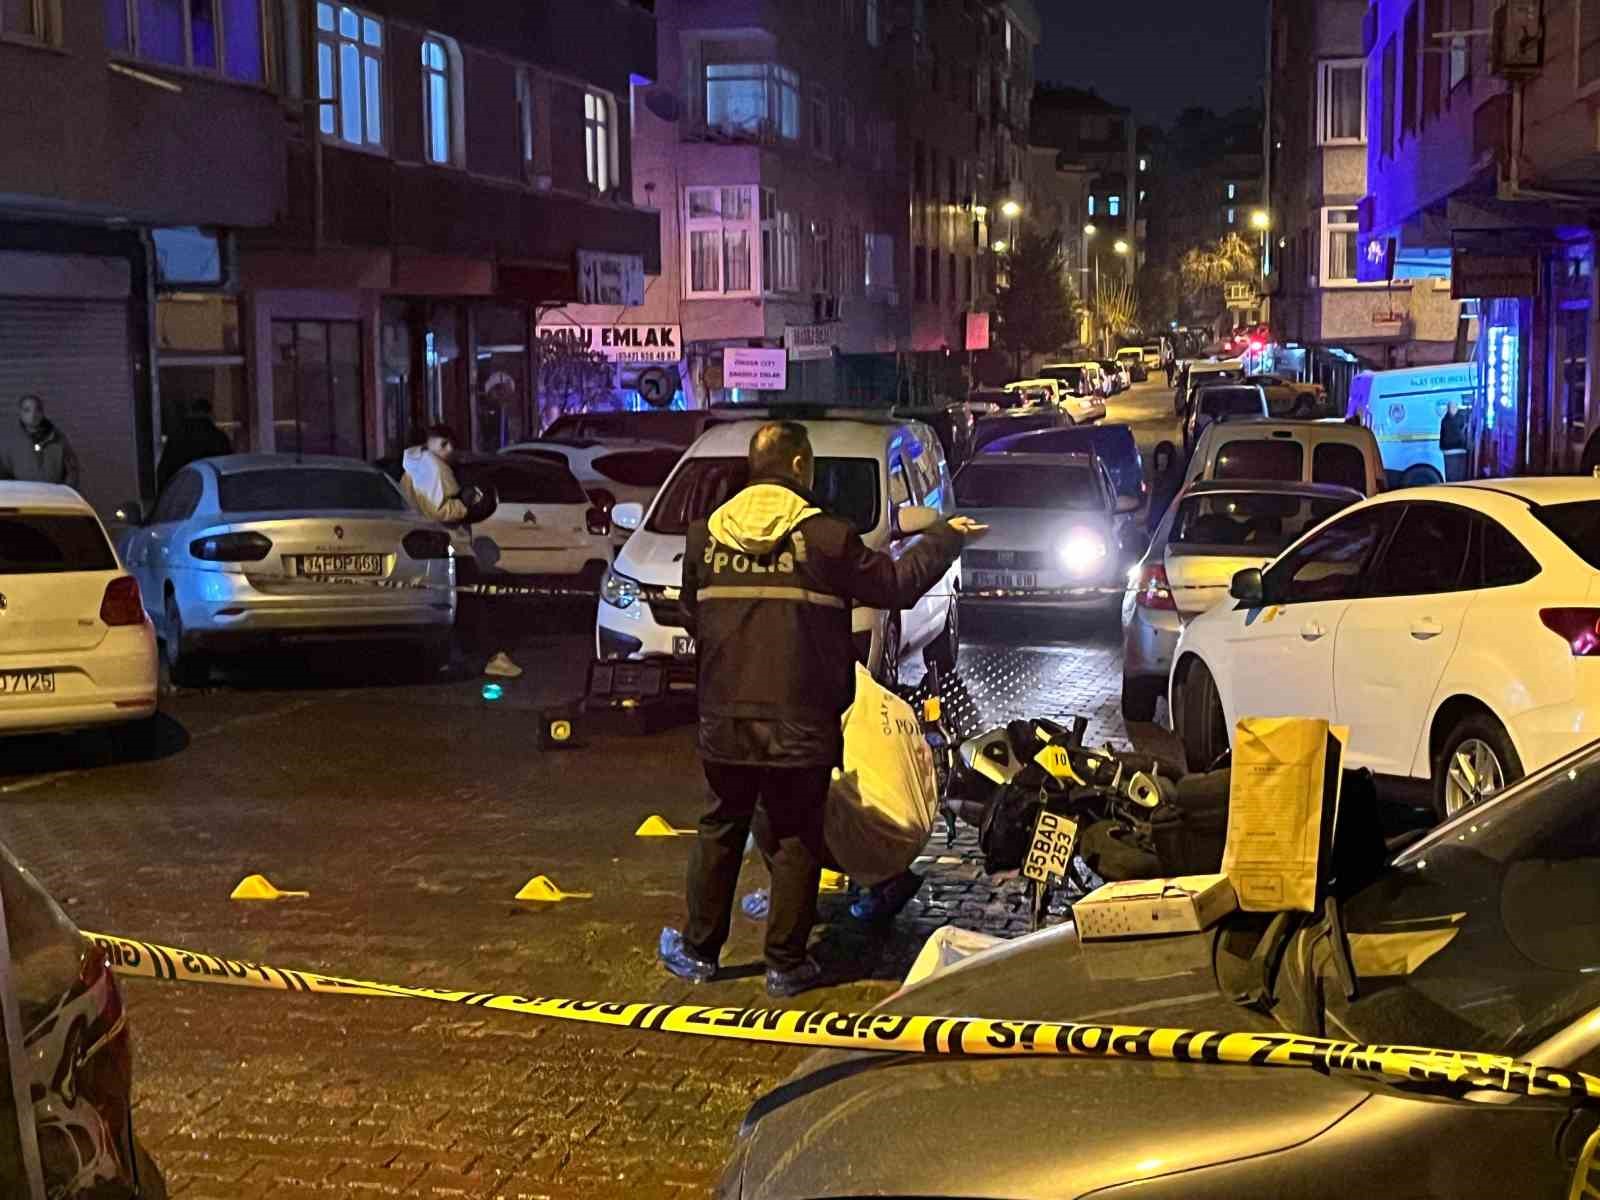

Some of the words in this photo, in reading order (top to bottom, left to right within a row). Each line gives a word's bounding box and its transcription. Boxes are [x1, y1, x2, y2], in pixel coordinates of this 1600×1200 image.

[601, 328, 675, 347] EMLAK
[713, 551, 794, 574] POLS
[1054, 752, 1067, 766] 10
[1050, 831, 1072, 868] 253
[986, 1020, 1156, 1057] POLİS
